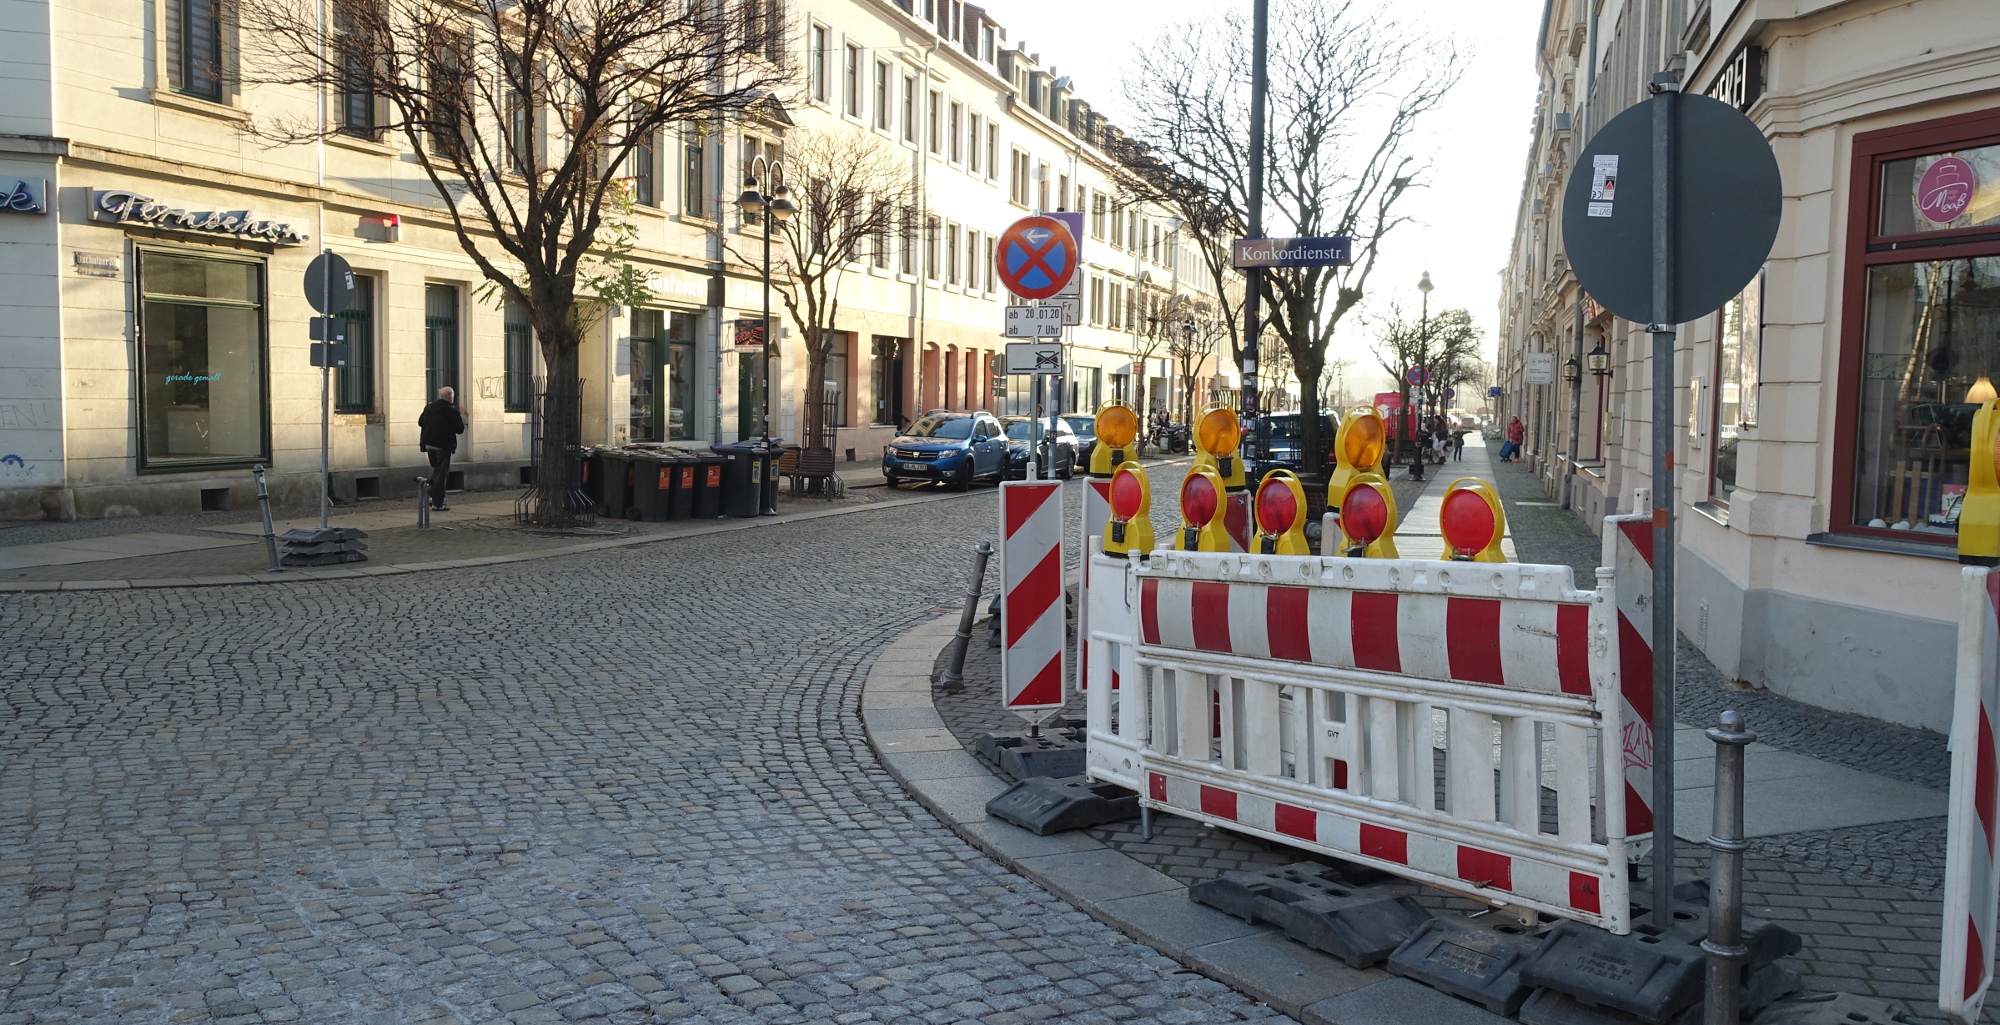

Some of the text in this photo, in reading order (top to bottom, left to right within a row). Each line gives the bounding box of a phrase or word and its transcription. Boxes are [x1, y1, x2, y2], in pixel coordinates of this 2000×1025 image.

[101, 190, 310, 243] Fernsehen
[1242, 245, 1344, 261] Konkordienstr.
[1008, 309, 1019, 319] ab
[1008, 324, 1059, 335] ab 7 Uhr
[165, 371, 222, 385] gerade gemalt
[1327, 729, 1340, 739] GVT
